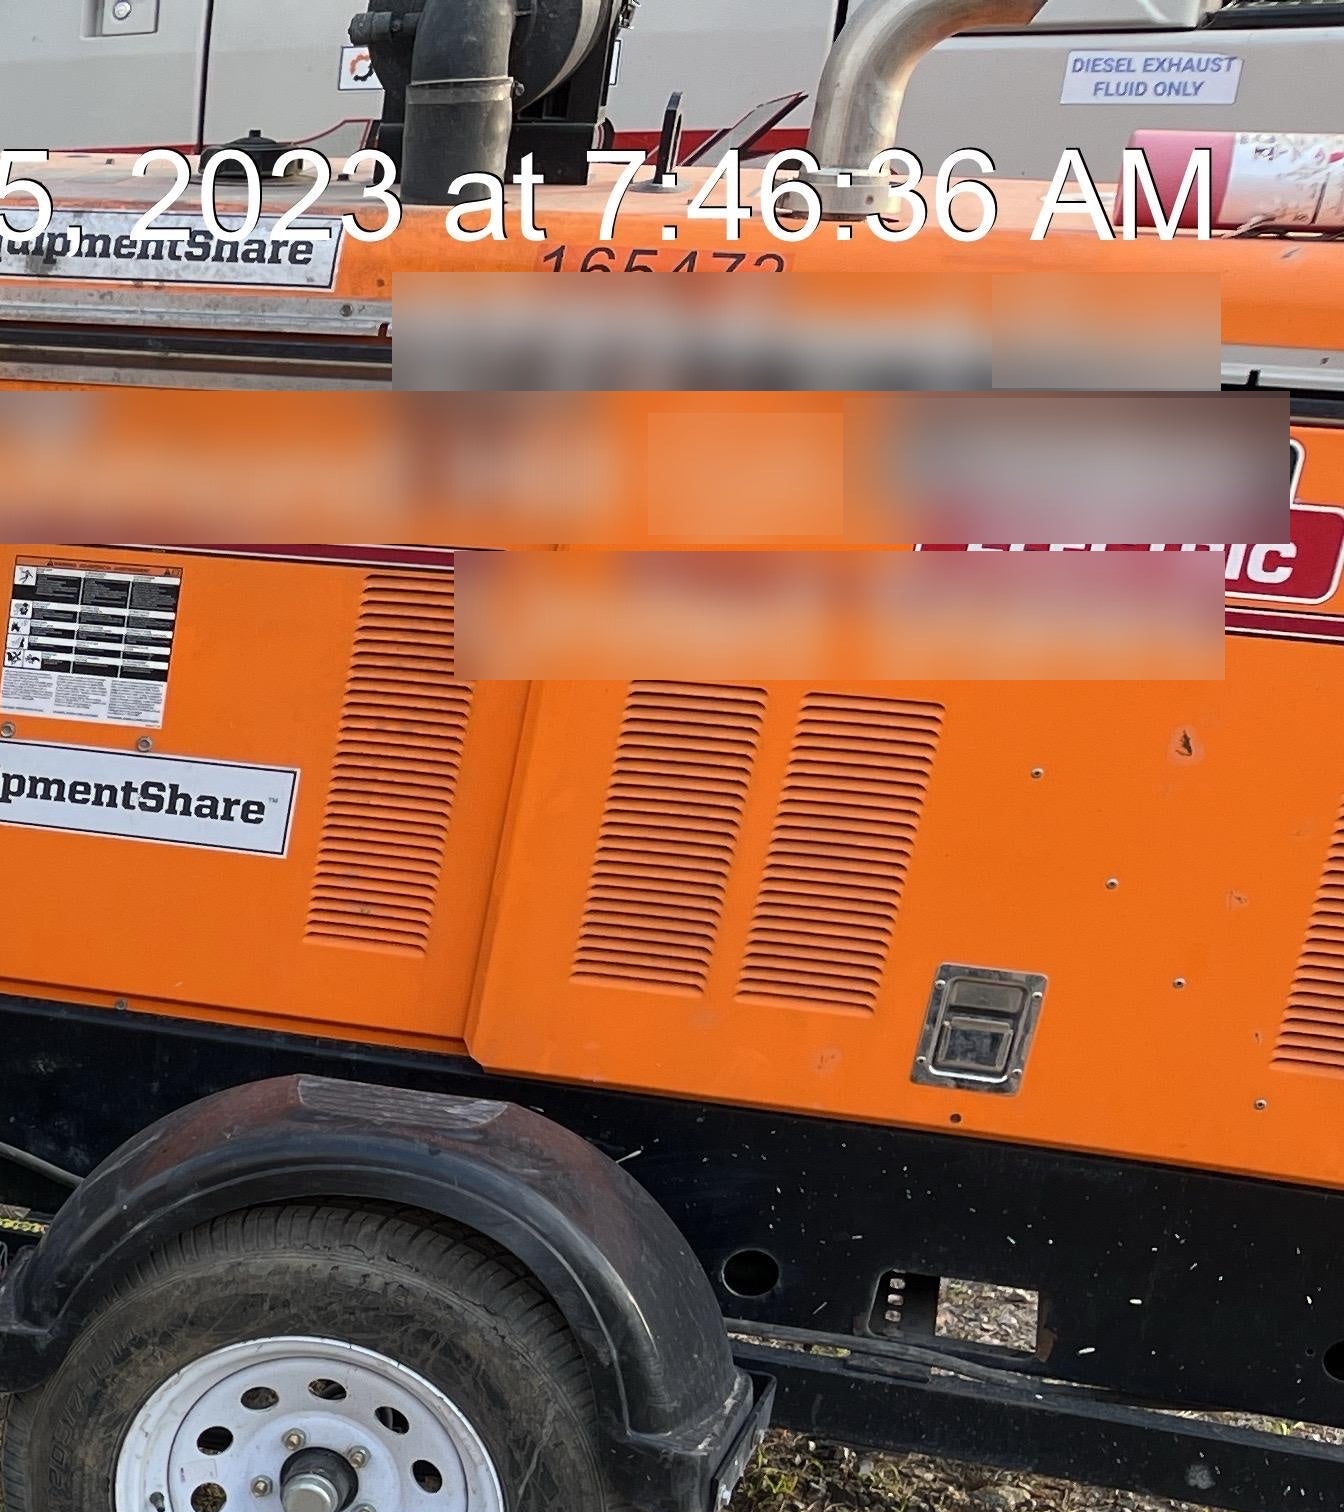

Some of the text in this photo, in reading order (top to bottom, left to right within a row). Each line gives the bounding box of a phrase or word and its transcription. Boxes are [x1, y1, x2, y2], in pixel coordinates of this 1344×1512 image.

[1072, 56, 1238, 73] DIESEL EXHAUST
[1093, 81, 1206, 97] FLUID ONLY
